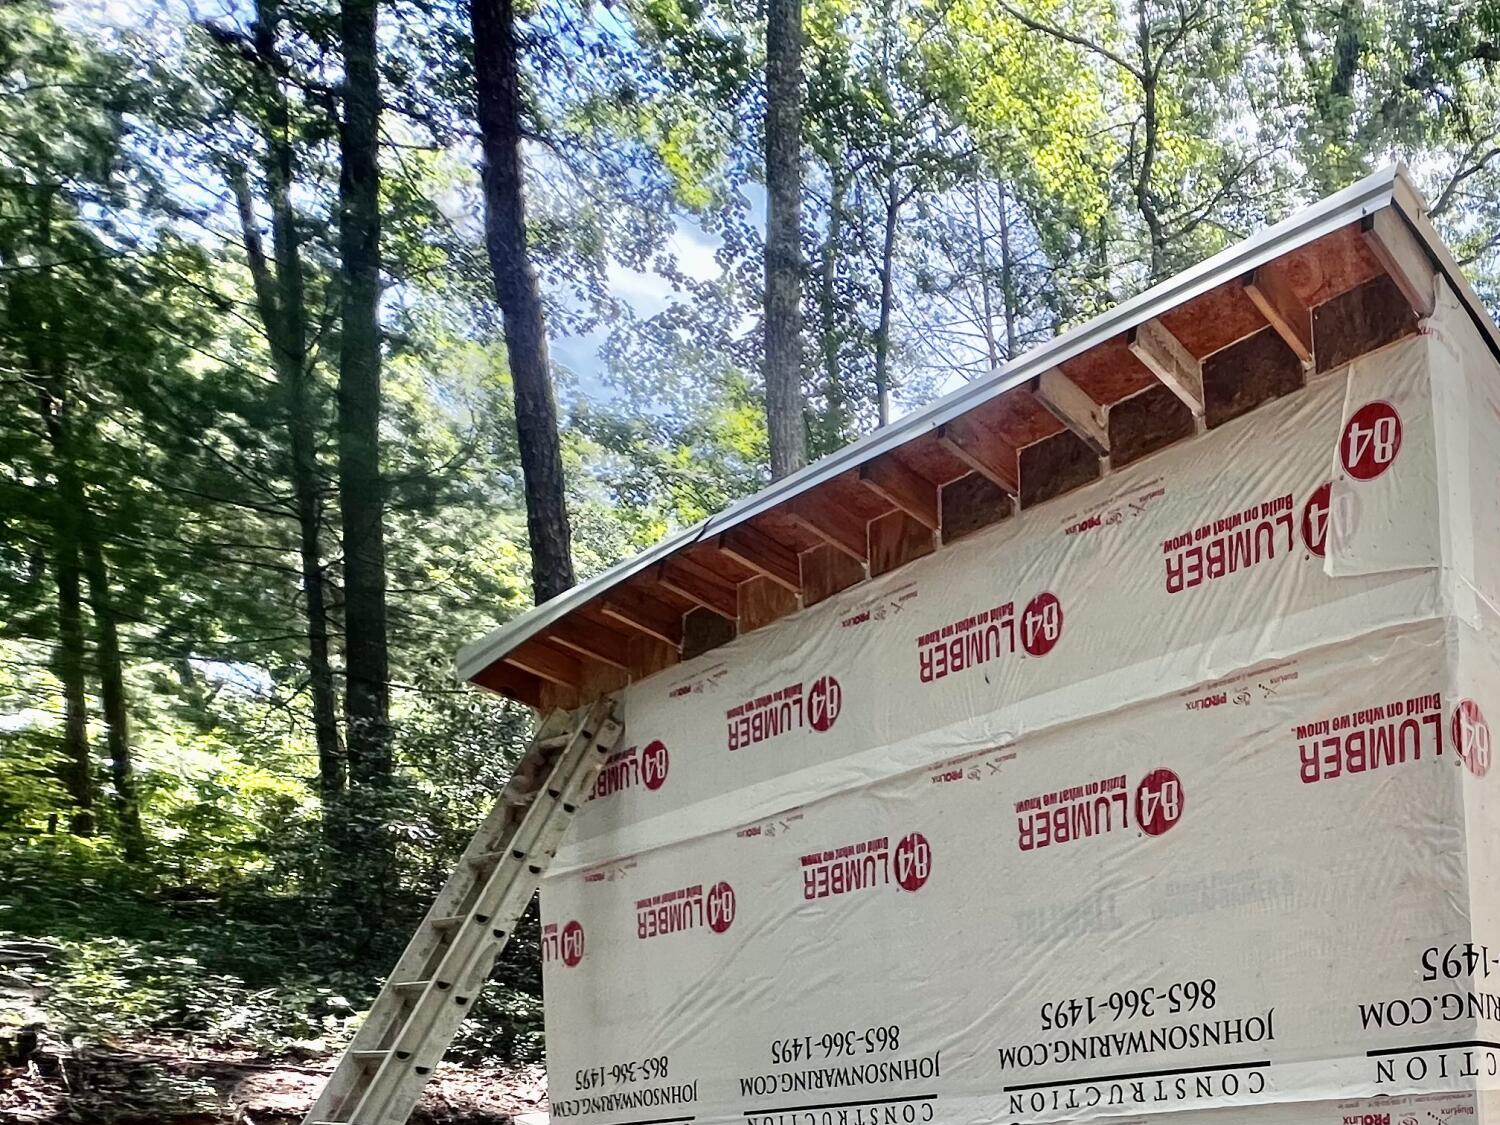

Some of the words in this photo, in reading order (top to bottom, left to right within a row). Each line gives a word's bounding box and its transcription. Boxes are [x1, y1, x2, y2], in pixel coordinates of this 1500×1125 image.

[1344, 414, 1399, 470] 84
[1212, 512, 1242, 536] what
[1243, 507, 1258, 525] on
[1261, 493, 1293, 518] Build
[1165, 512, 1294, 594] LUMBER
[1195, 524, 1211, 542] we
[919, 618, 1015, 684] LUMBER
[1185, 693, 1227, 712] PROLinx
[1352, 705, 1384, 729] what
[1385, 700, 1403, 719] on
[1406, 692, 1441, 717] Build
[727, 698, 803, 752] LUMBER
[1332, 714, 1350, 732] we
[1298, 712, 1443, 784] LUMBER
[588, 758, 639, 801] LUMB
[1084, 781, 1098, 796] on
[1100, 774, 1127, 792] Build
[1017, 792, 1129, 851] LUMBER
[802, 852, 889, 900] LUMBER
[636, 898, 703, 940] LUMBER
[1040, 978, 1216, 1031] 865-366-1495
[770, 1025, 901, 1065] 865-366-1495
[998, 1008, 1275, 1070] JOHNSONWARING.COM
[574, 1054, 669, 1091] 865-366-1495
[739, 1050, 941, 1097] JOHNSONWARING.COM
[1008, 1071, 1265, 1114] CONSTRUCTION
[551, 1079, 698, 1118] JOHNSONWARING.COM
